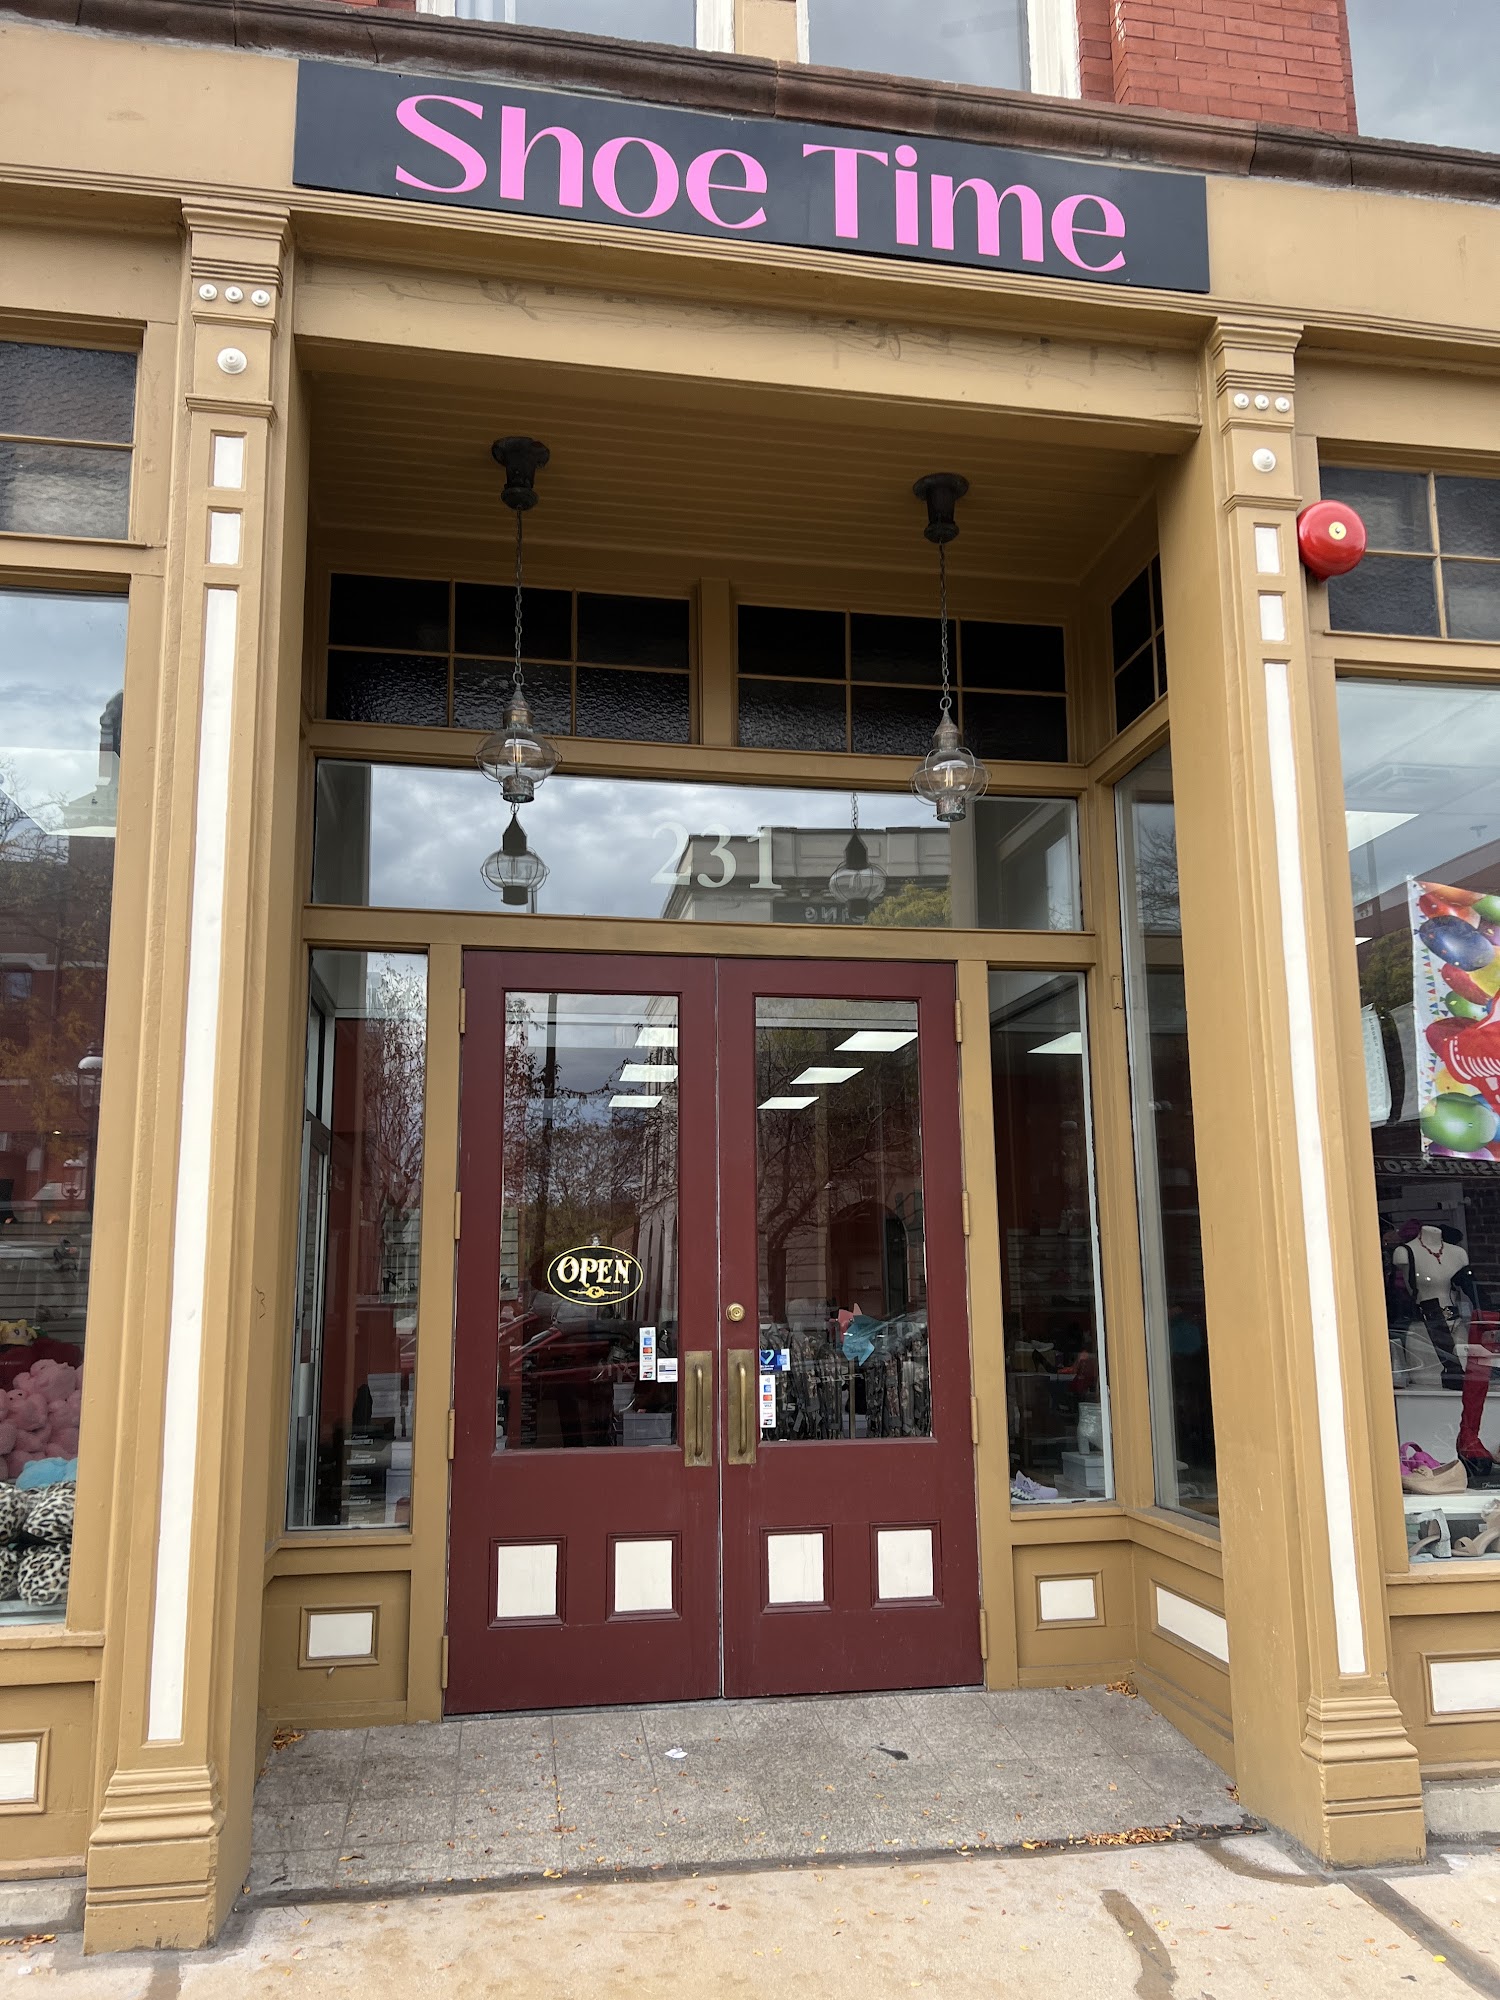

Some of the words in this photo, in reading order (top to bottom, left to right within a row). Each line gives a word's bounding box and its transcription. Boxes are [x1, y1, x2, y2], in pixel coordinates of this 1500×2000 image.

[395, 93, 768, 230] Shoe
[802, 144, 1127, 273] Time
[649, 820, 782, 890] 231
[556, 1255, 632, 1288] OPEN
